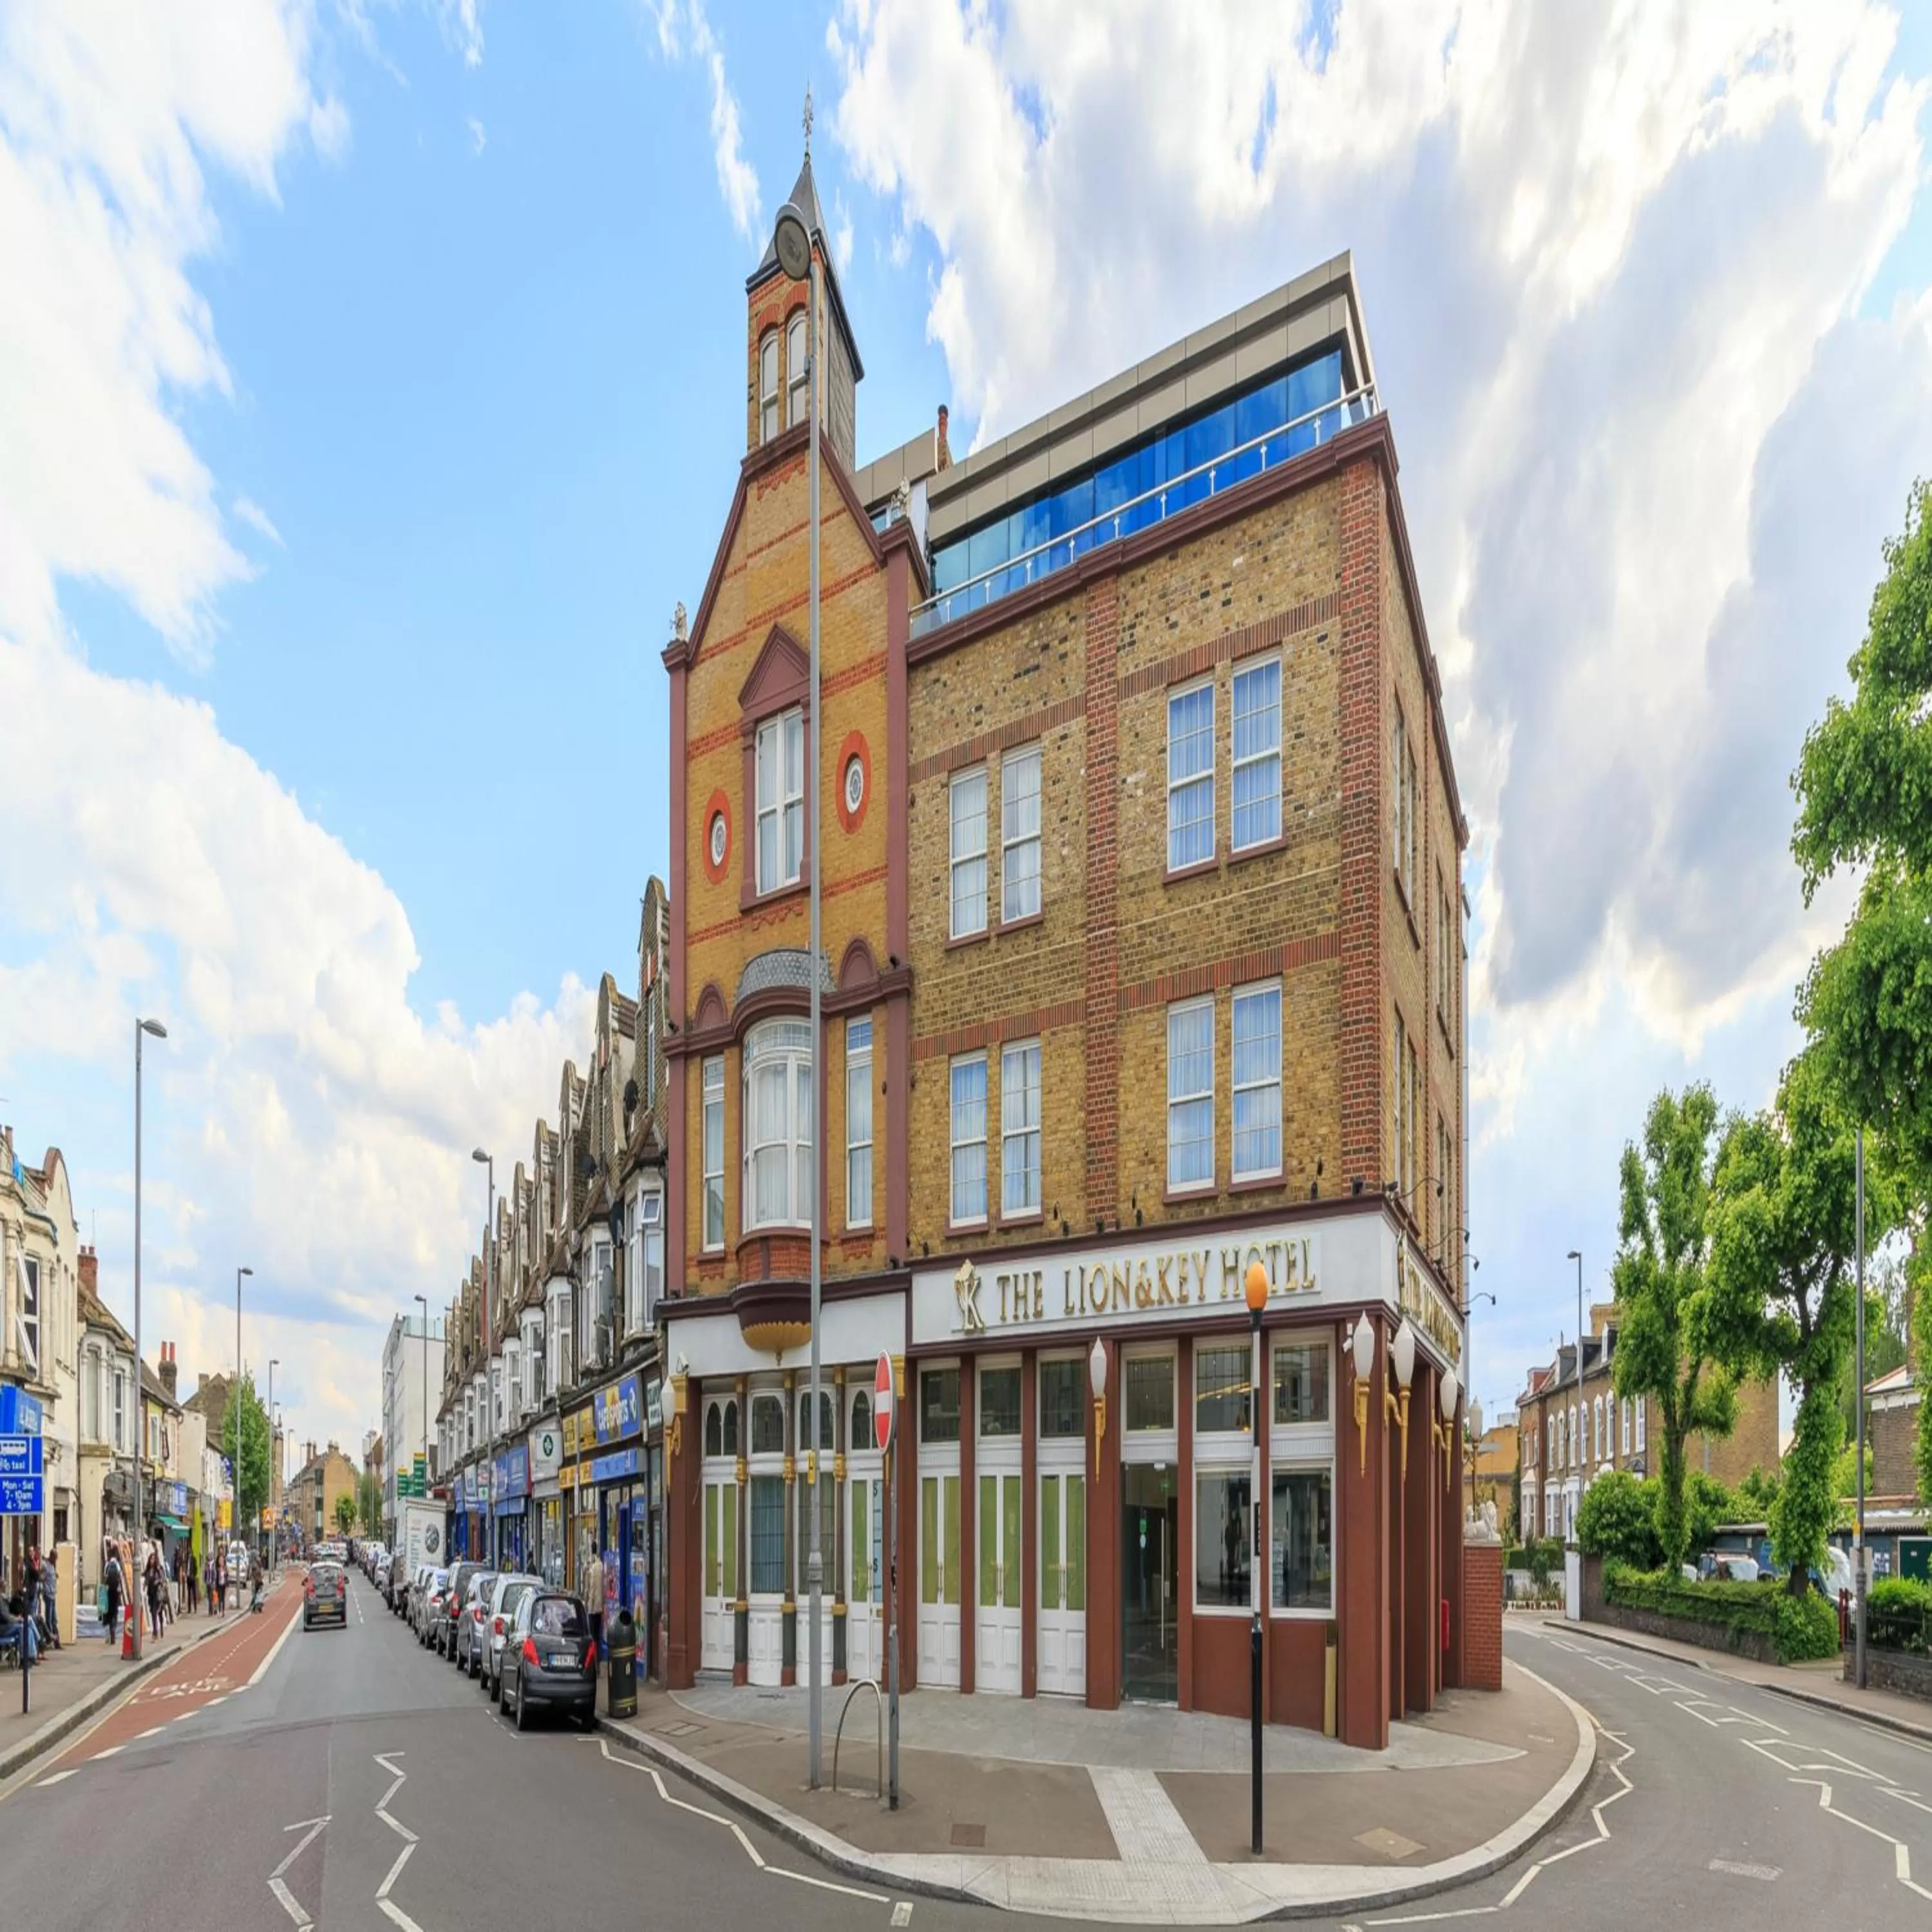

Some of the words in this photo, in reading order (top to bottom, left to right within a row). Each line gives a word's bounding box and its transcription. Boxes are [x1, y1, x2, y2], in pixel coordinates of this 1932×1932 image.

[997, 1271, 1043, 1322] THE
[1064, 1249, 1211, 1316] LION&KEY
[12, 1460, 25, 1470] taxi
[2, 1480, 17, 1490] Mon
[22, 1480, 34, 1490] Sat
[5, 1490, 9, 1499] 7
[15, 1490, 32, 1499] 10am
[6, 1500, 12, 1510] 4
[17, 1500, 32, 1511] 7pm
